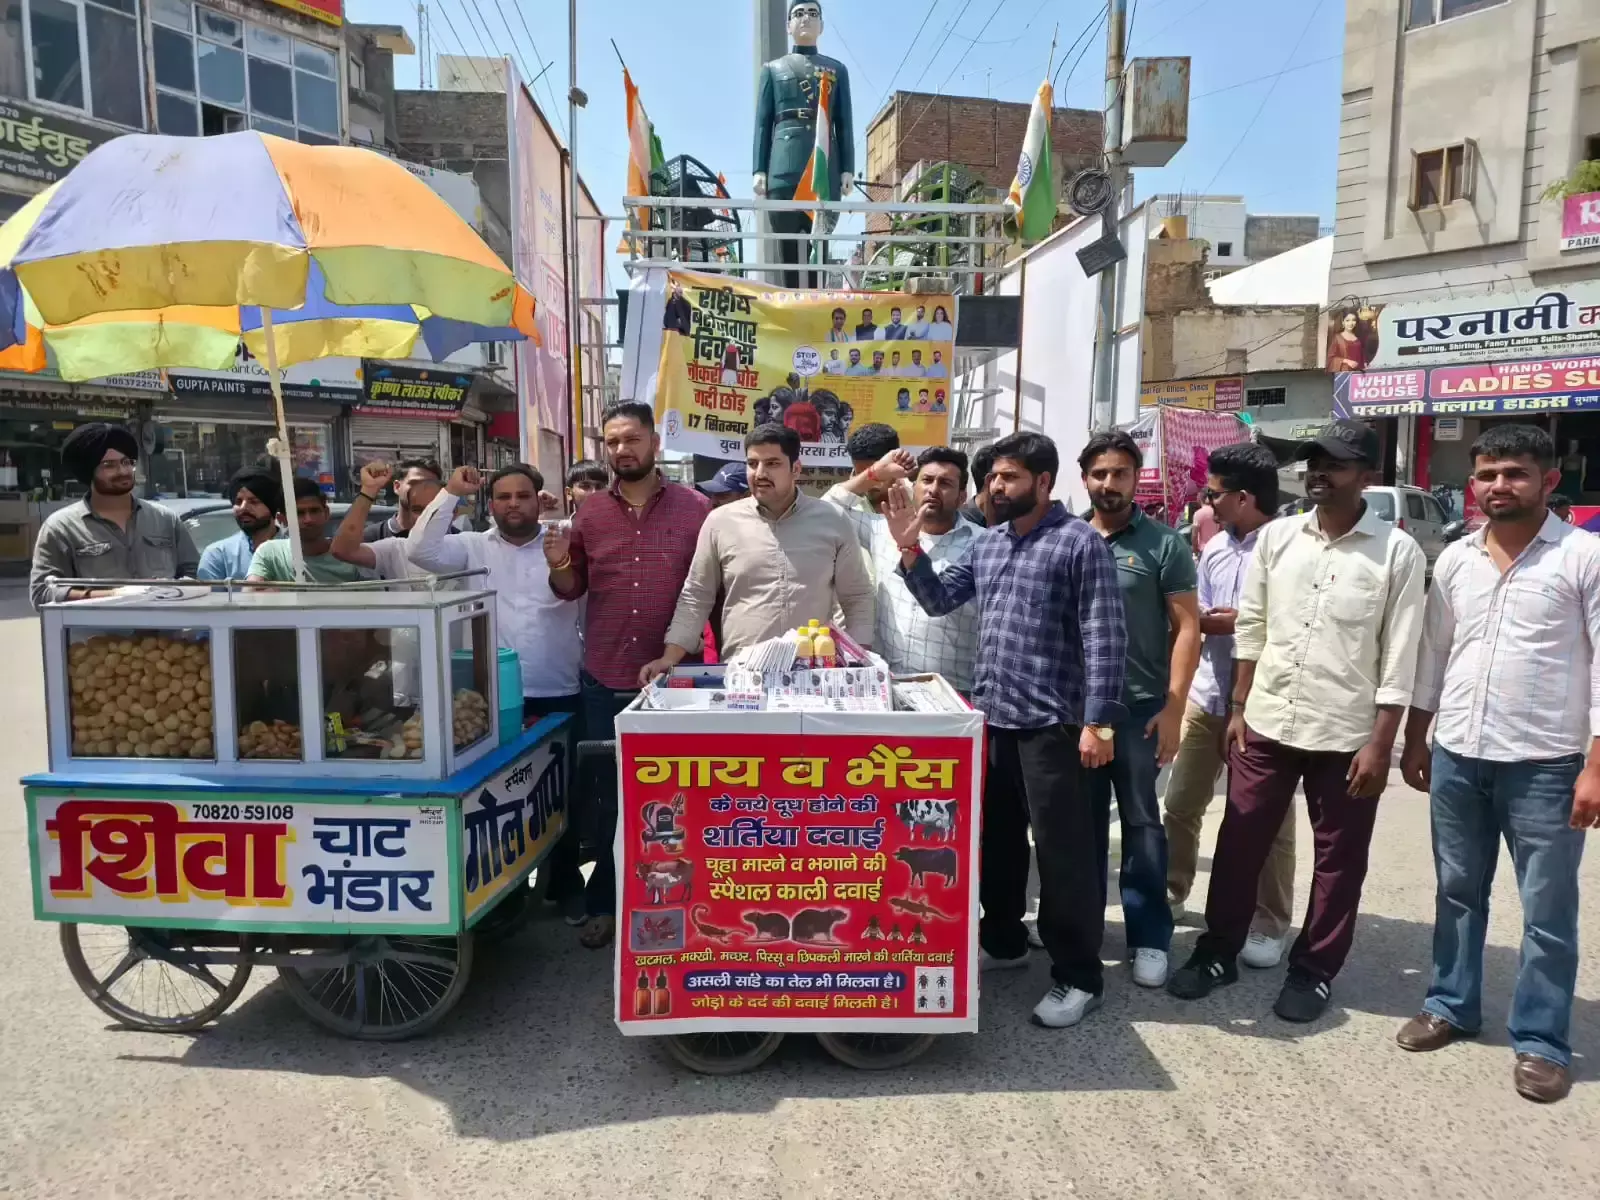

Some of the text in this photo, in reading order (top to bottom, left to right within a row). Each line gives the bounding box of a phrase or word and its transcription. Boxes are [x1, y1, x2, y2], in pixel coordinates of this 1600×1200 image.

[1392, 292, 1575, 341] परनामी
[1449, 340, 1482, 351] Shirting,
[1484, 338, 1509, 349] Fancy
[1511, 335, 1538, 346] Ladies
[176, 378, 210, 392] GUPTA
[212, 380, 246, 393] PAINTS
[1354, 385, 1419, 399] HOUSE
[1358, 373, 1417, 388] WHITE
[1440, 372, 1553, 394] LADIES
[720, 389, 748, 416] छोड़
[1352, 399, 1427, 416] परनामी
[688, 413, 748, 436] 17 सितम्बर
[720, 439, 740, 454] युवा
[634, 743, 960, 790] गाय व भैंस
[709, 793, 879, 818] के नये दूध होने की
[313, 816, 411, 857] चाट
[464, 787, 526, 893] गोल
[703, 816, 886, 850] शर्तिया दवाई
[46, 800, 291, 903] शिवा
[705, 852, 887, 878] चूहा मारने व भगाने की
[302, 860, 434, 912] भंडार
[776, 876, 828, 901] काली
[833, 876, 882, 902] दवाई
[756, 949, 785, 967] पिस्सू
[786, 953, 794, 963] व
[797, 949, 841, 963] छिपकली
[844, 949, 871, 963] मारने
[874, 949, 889, 962] की
[892, 949, 924, 963] शर्तिया
[927, 949, 954, 964] दवाई
[688, 971, 731, 988] असली
[735, 972, 761, 988] सांडे
[765, 975, 785, 988] का
[788, 973, 812, 988] तेल
[815, 973, 833, 988] भी
[836, 973, 880, 988] मिलता
[729, 994, 743, 1009] के
[747, 995, 769, 1009] दर्द
[772, 994, 791, 1009] की
[795, 992, 829, 1010] दवाई
[833, 994, 877, 1009] मिलती
